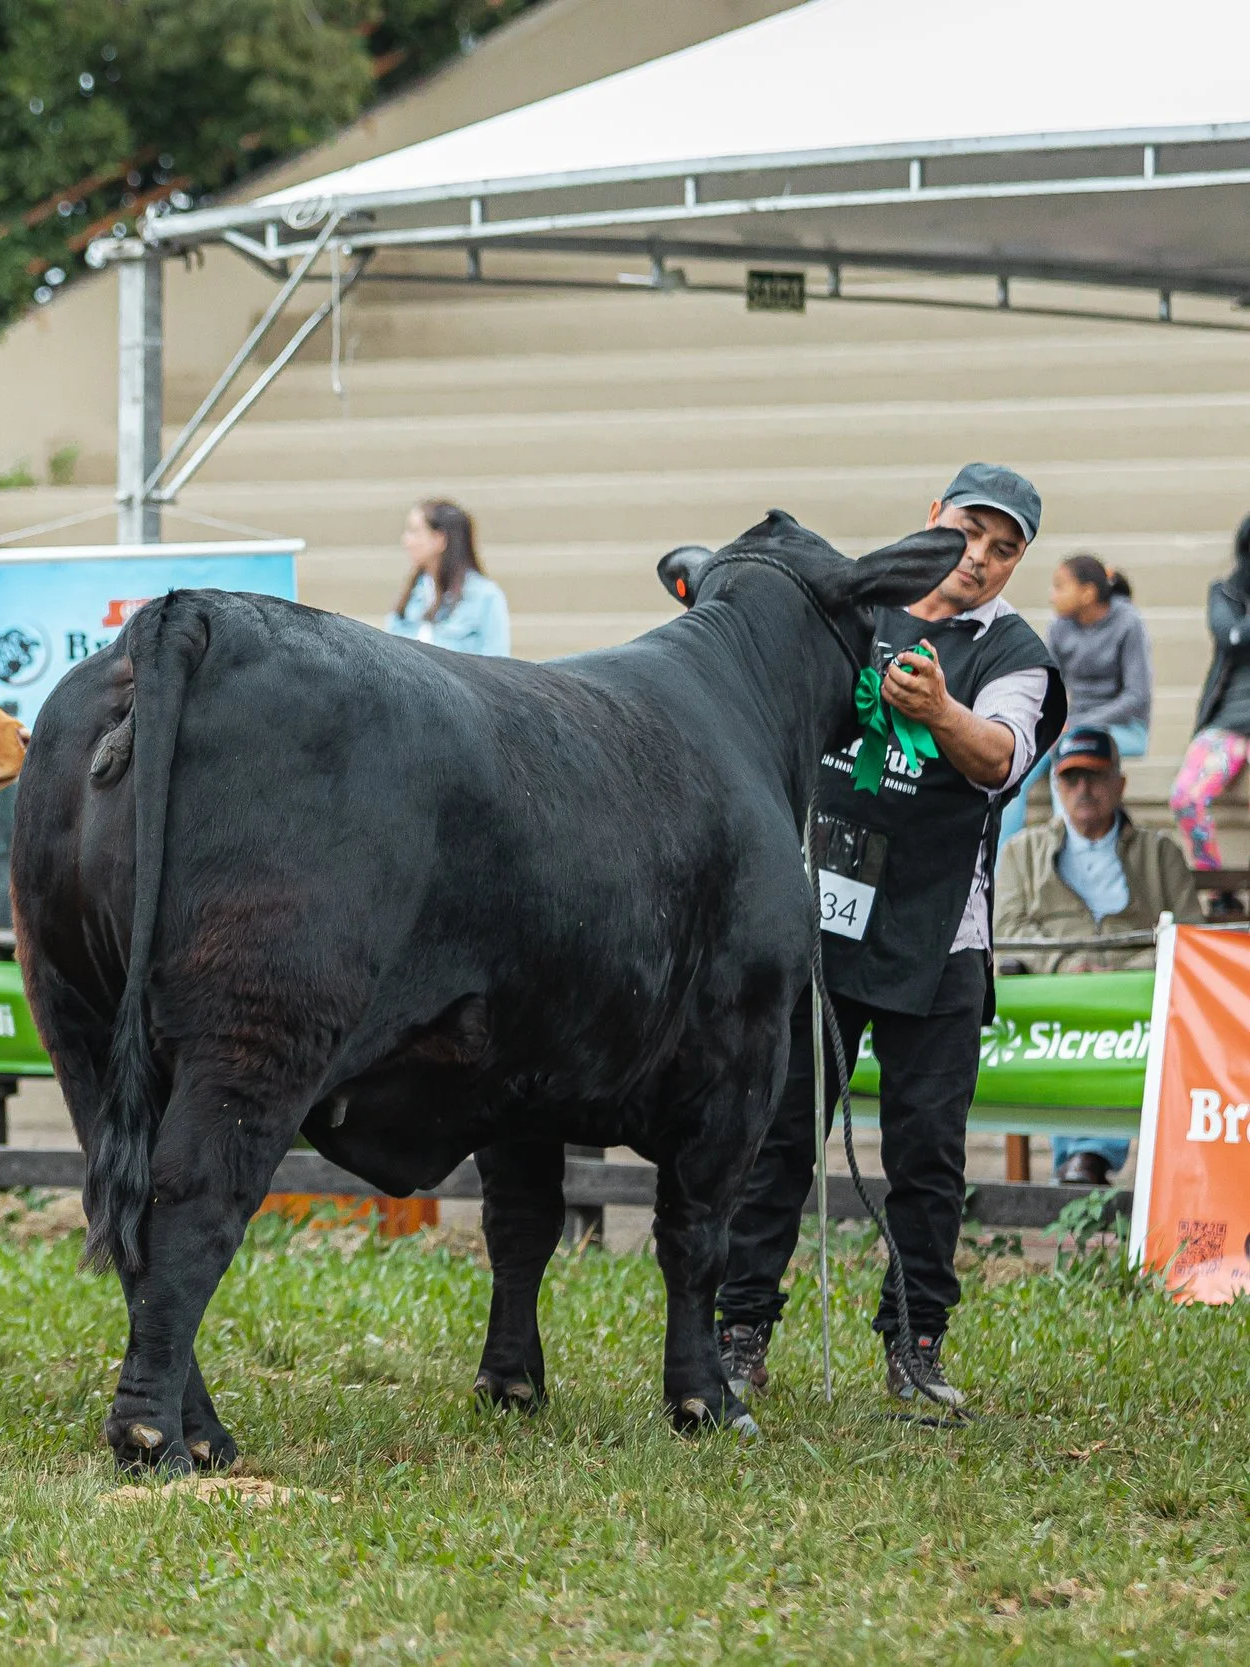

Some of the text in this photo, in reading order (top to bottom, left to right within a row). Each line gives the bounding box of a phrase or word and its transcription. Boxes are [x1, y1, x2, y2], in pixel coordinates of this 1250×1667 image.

[884, 777, 918, 796] BRANGUS
[821, 892, 857, 927] 34
[1023, 1020, 1151, 1060] Sicredi
[1185, 1087, 1250, 1144] Br
